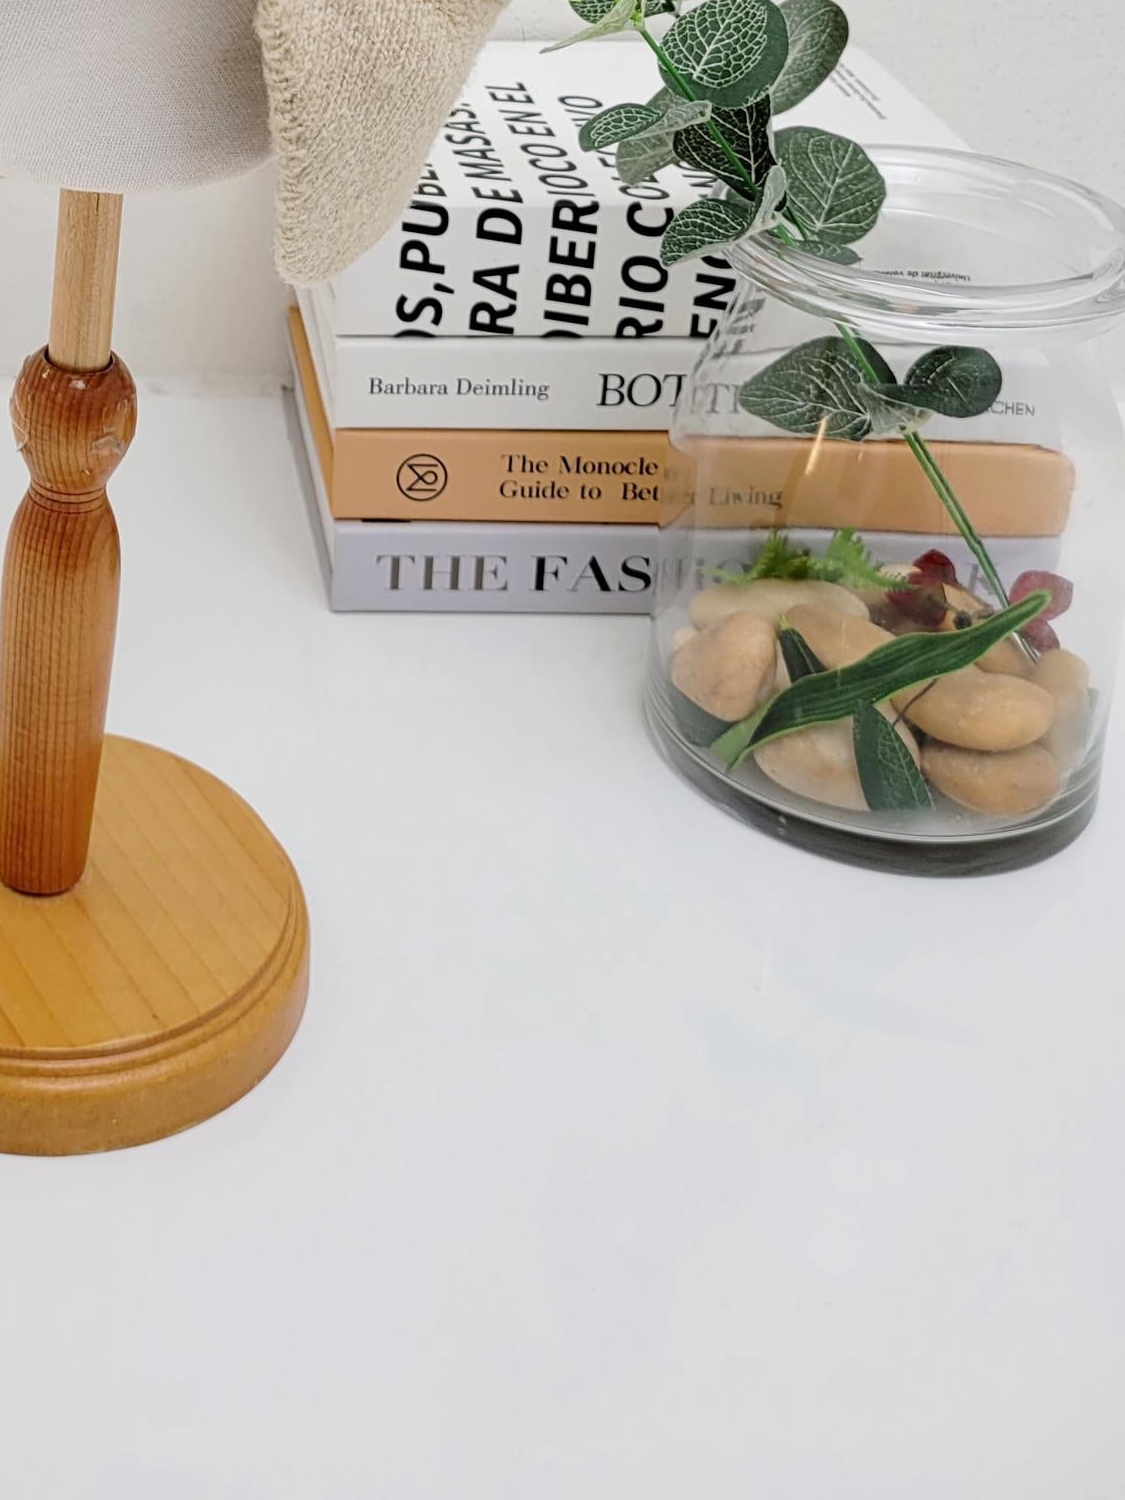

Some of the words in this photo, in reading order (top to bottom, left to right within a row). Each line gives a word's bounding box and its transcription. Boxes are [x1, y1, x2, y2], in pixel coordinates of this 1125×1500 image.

[484, 81, 537, 105] EL
[508, 109, 557, 138] EN
[470, 186, 525, 245] DE
[540, 141, 600, 338] IBERIOCO
[394, 283, 455, 338] S,
[369, 377, 448, 395] Barbara
[456, 378, 550, 400] Deimling
[987, 400, 1036, 416] CHEN
[501, 453, 549, 475] The
[559, 456, 659, 476] Monocle
[499, 480, 570, 500] Guide
[579, 483, 603, 501] to
[376, 554, 508, 592] THE
